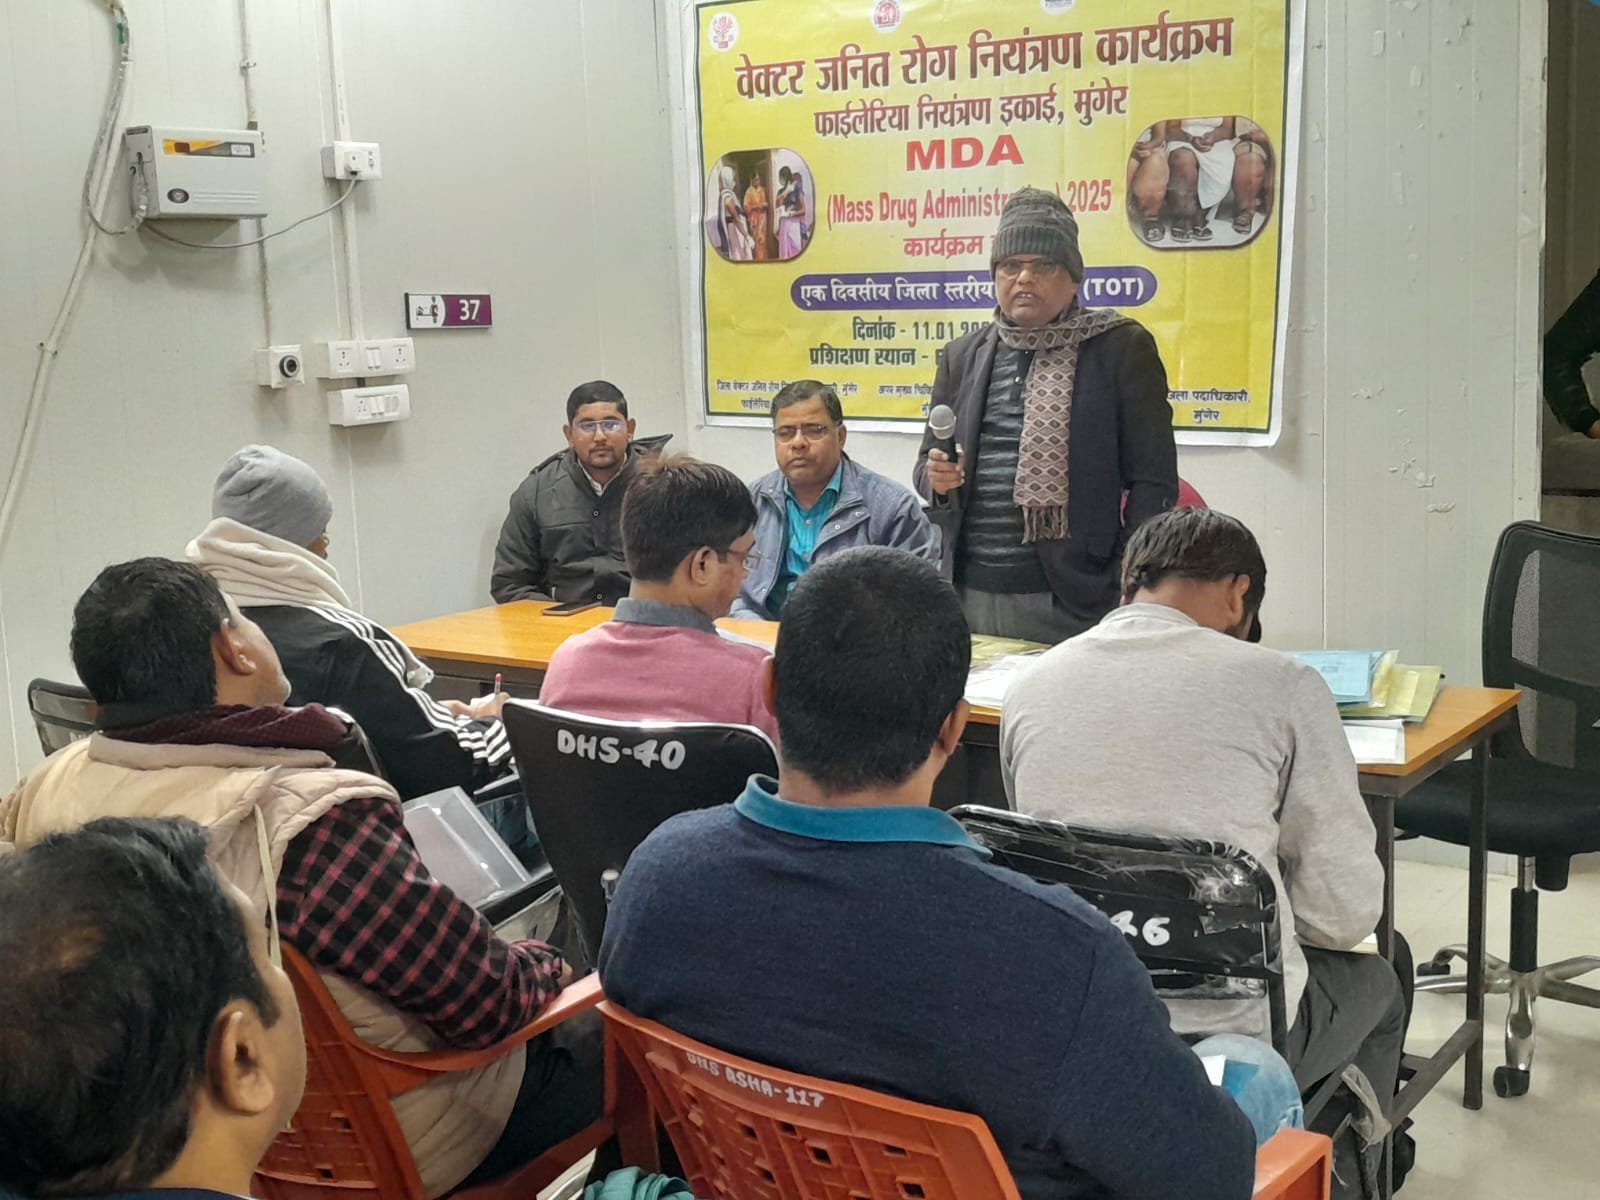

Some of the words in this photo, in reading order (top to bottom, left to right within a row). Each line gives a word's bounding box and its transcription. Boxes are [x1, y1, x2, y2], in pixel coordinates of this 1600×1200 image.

[735, 54, 805, 99] वेक्टर
[815, 43, 890, 91] जनित
[900, 35, 957, 84] रोग
[968, 27, 1083, 78] नियंत्रण
[1095, 10, 1234, 65] कार्यक्रम
[814, 99, 910, 138] फाईलेरिया
[917, 93, 992, 130] नियंत्रण
[999, 83, 1065, 126] इकाई,
[1073, 77, 1128, 126] मुंगेर
[906, 134, 1025, 171] MDA
[827, 193, 874, 231] (Mass
[879, 191, 917, 228] Drug
[1067, 179, 1111, 213] 2025
[904, 229, 985, 259] कार्यक्रम
[800, 284, 827, 307] एक
[831, 277, 892, 302] दिवसीय
[895, 276, 940, 301] जिला
[944, 275, 996, 303] स्तरीय
[1083, 278, 1144, 301] (TOT)
[459, 299, 480, 321] 37
[852, 315, 896, 341] दिनांक
[809, 342, 870, 366] प्रशिक्षण
[557, 728, 686, 770] DHS-40
[1110, 910, 1171, 946] 46
[725, 1065, 825, 1109] ASHA-117
